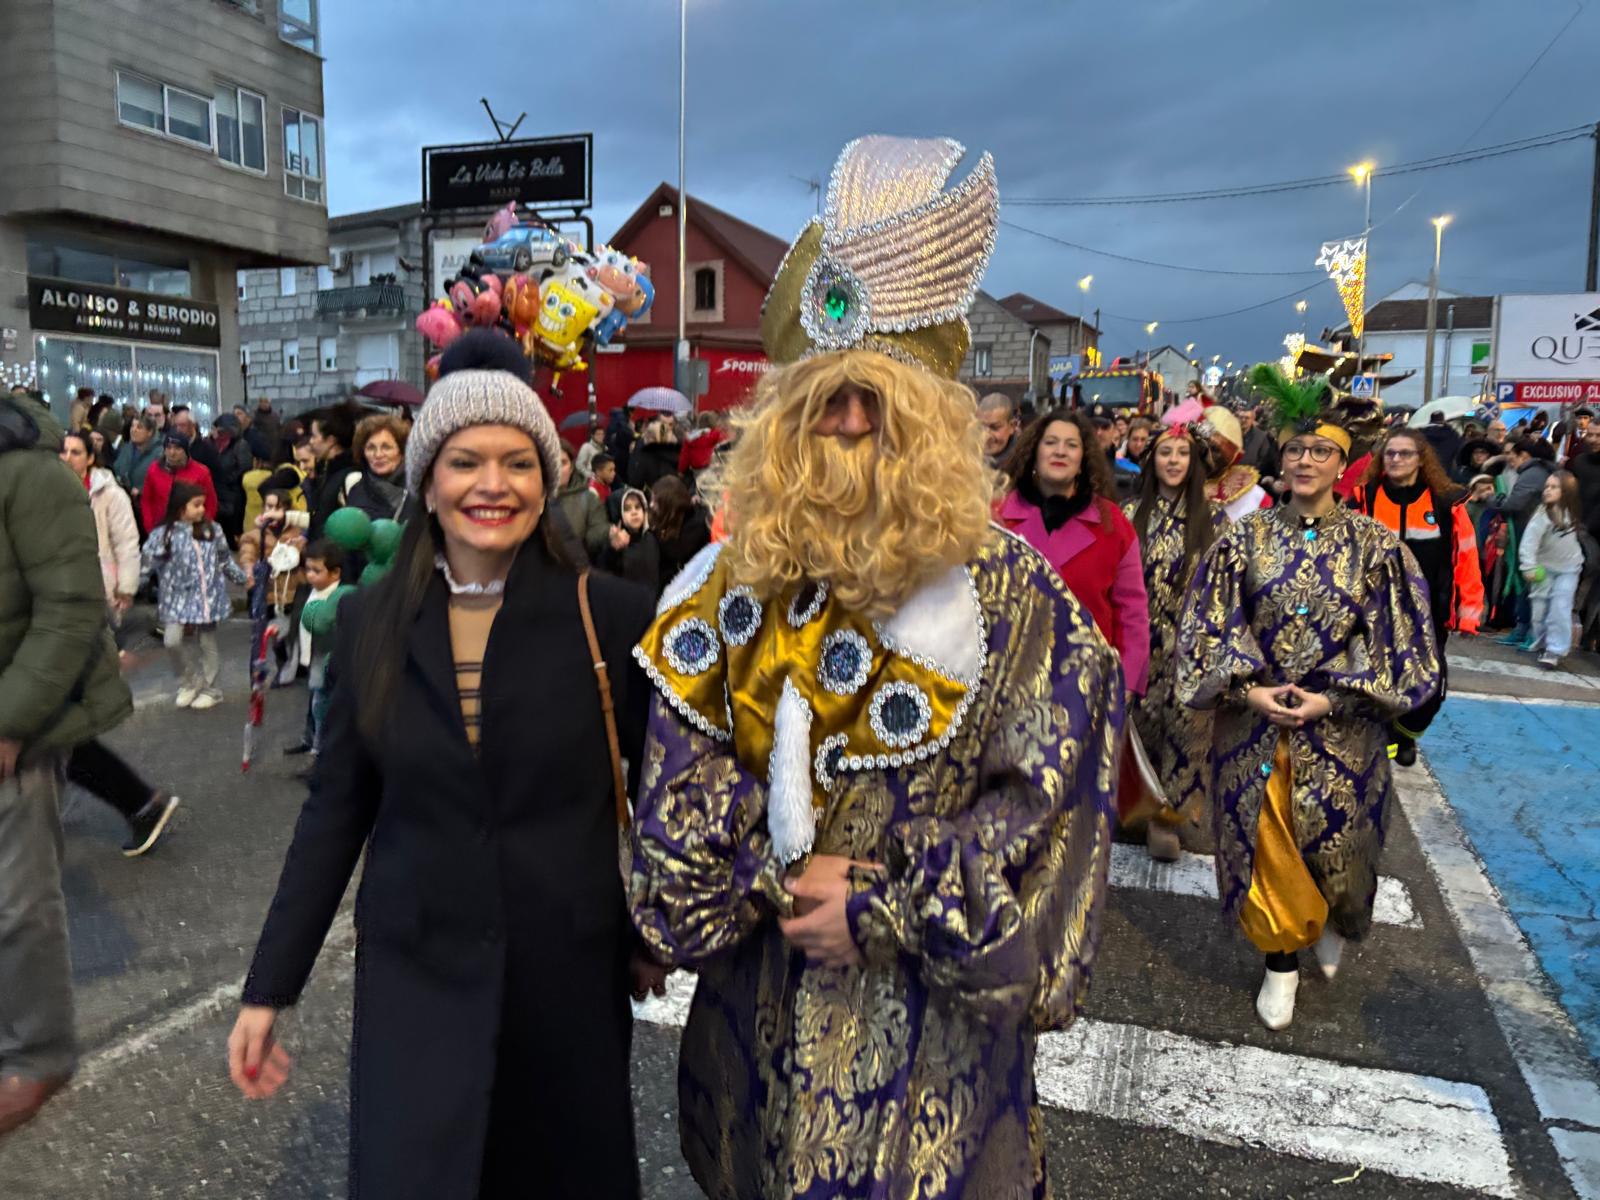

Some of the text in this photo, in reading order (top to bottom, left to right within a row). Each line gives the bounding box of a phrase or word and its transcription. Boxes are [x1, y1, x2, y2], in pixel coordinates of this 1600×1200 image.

[448, 156, 565, 184] La Vida Es Bella
[41, 288, 217, 327] ALONSO & SERODIO
[1521, 384, 1583, 400] EXCLUSIVO
